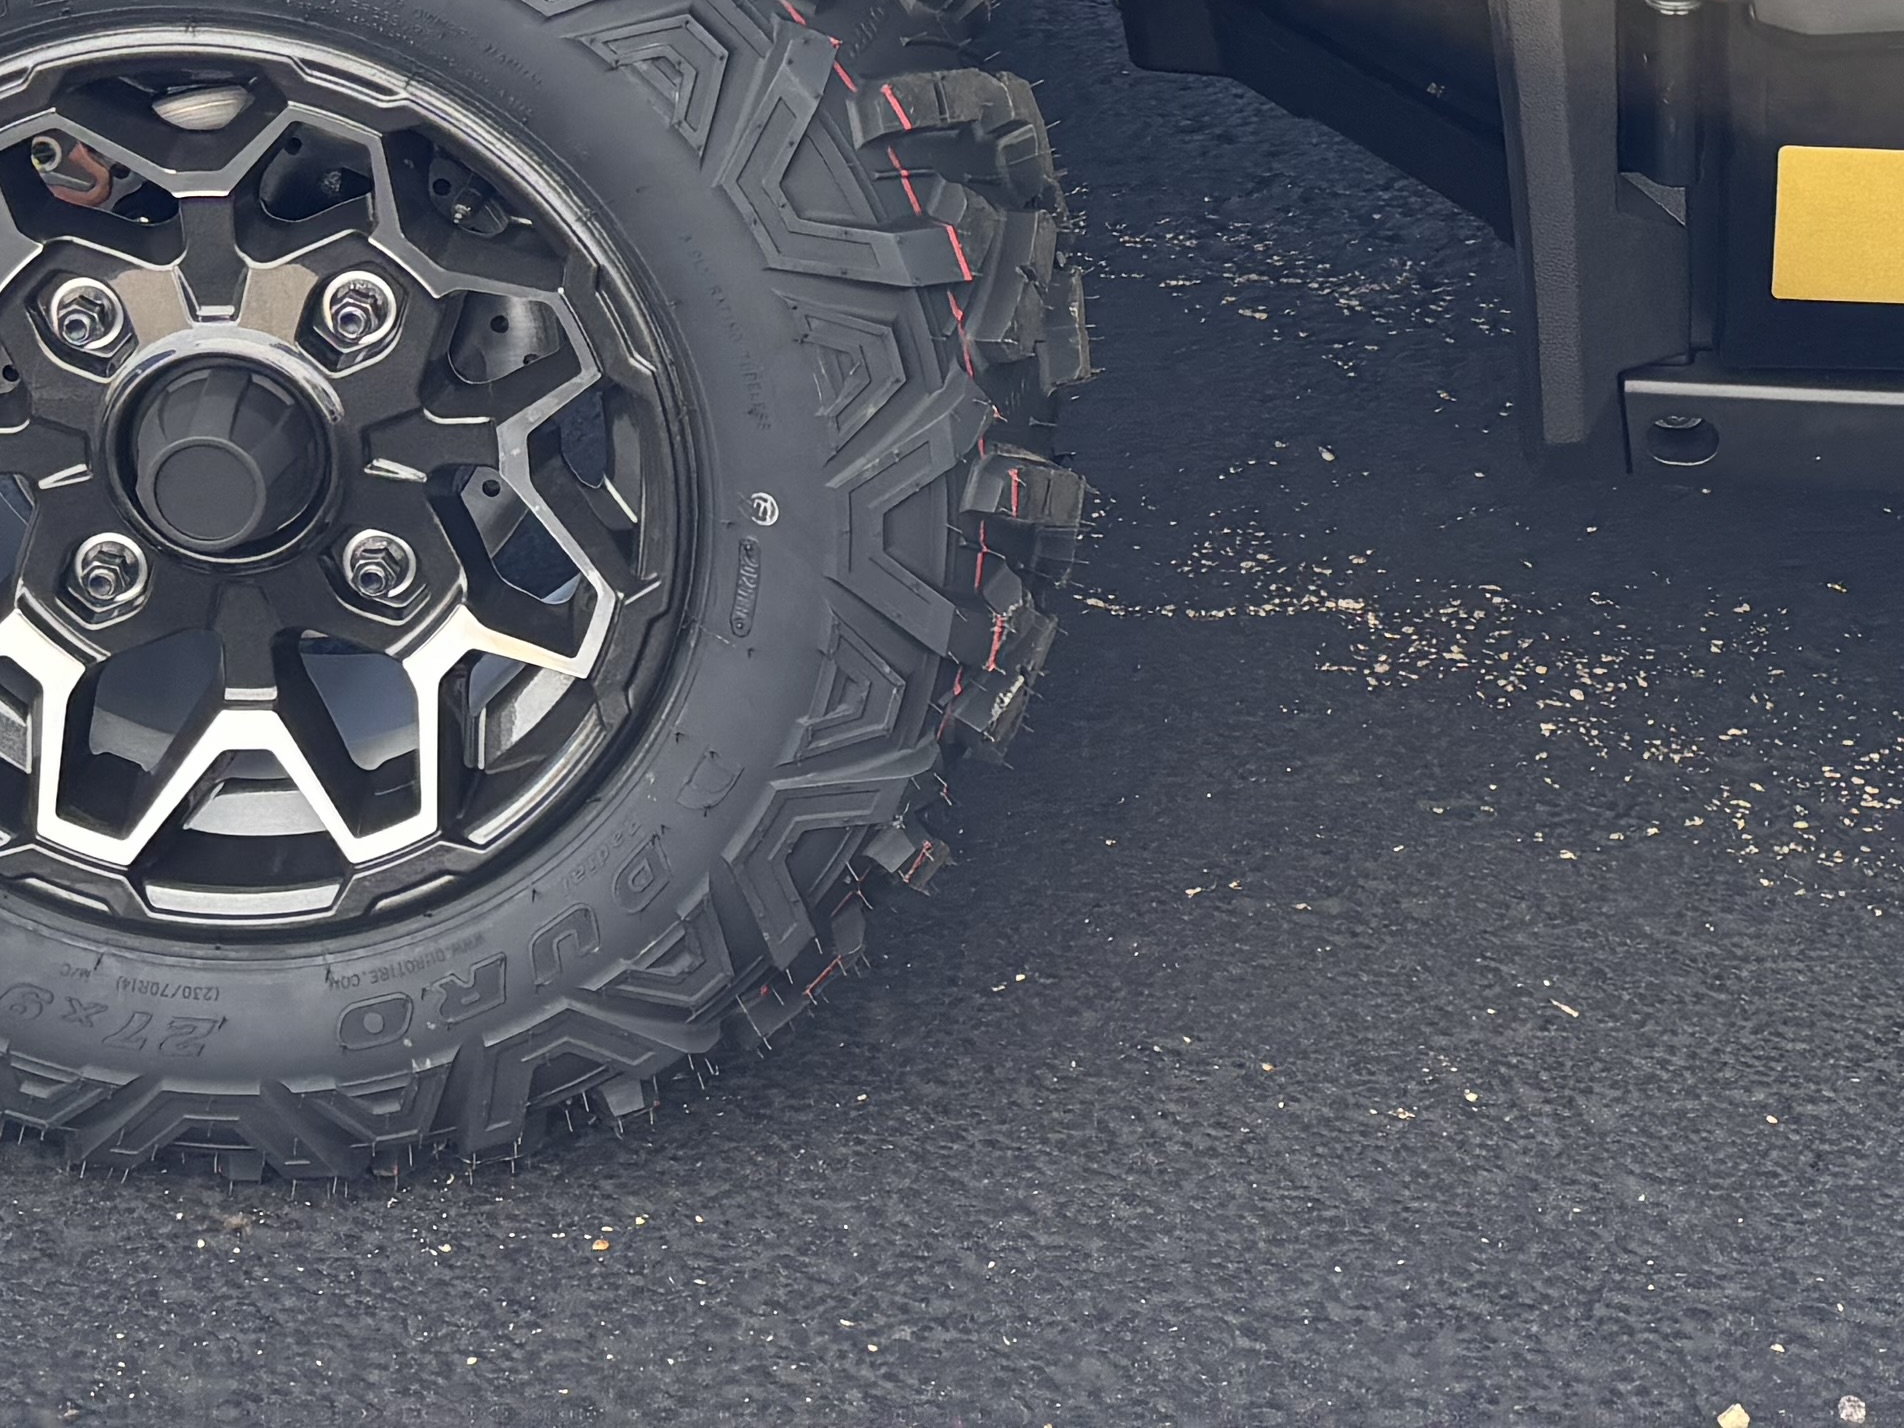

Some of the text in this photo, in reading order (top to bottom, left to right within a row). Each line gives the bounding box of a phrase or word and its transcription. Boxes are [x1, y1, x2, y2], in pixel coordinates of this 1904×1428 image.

[561, 813, 643, 897] Radial
[336, 833, 672, 1053] DURO
[114, 975, 219, 1001] (230/70R14)
